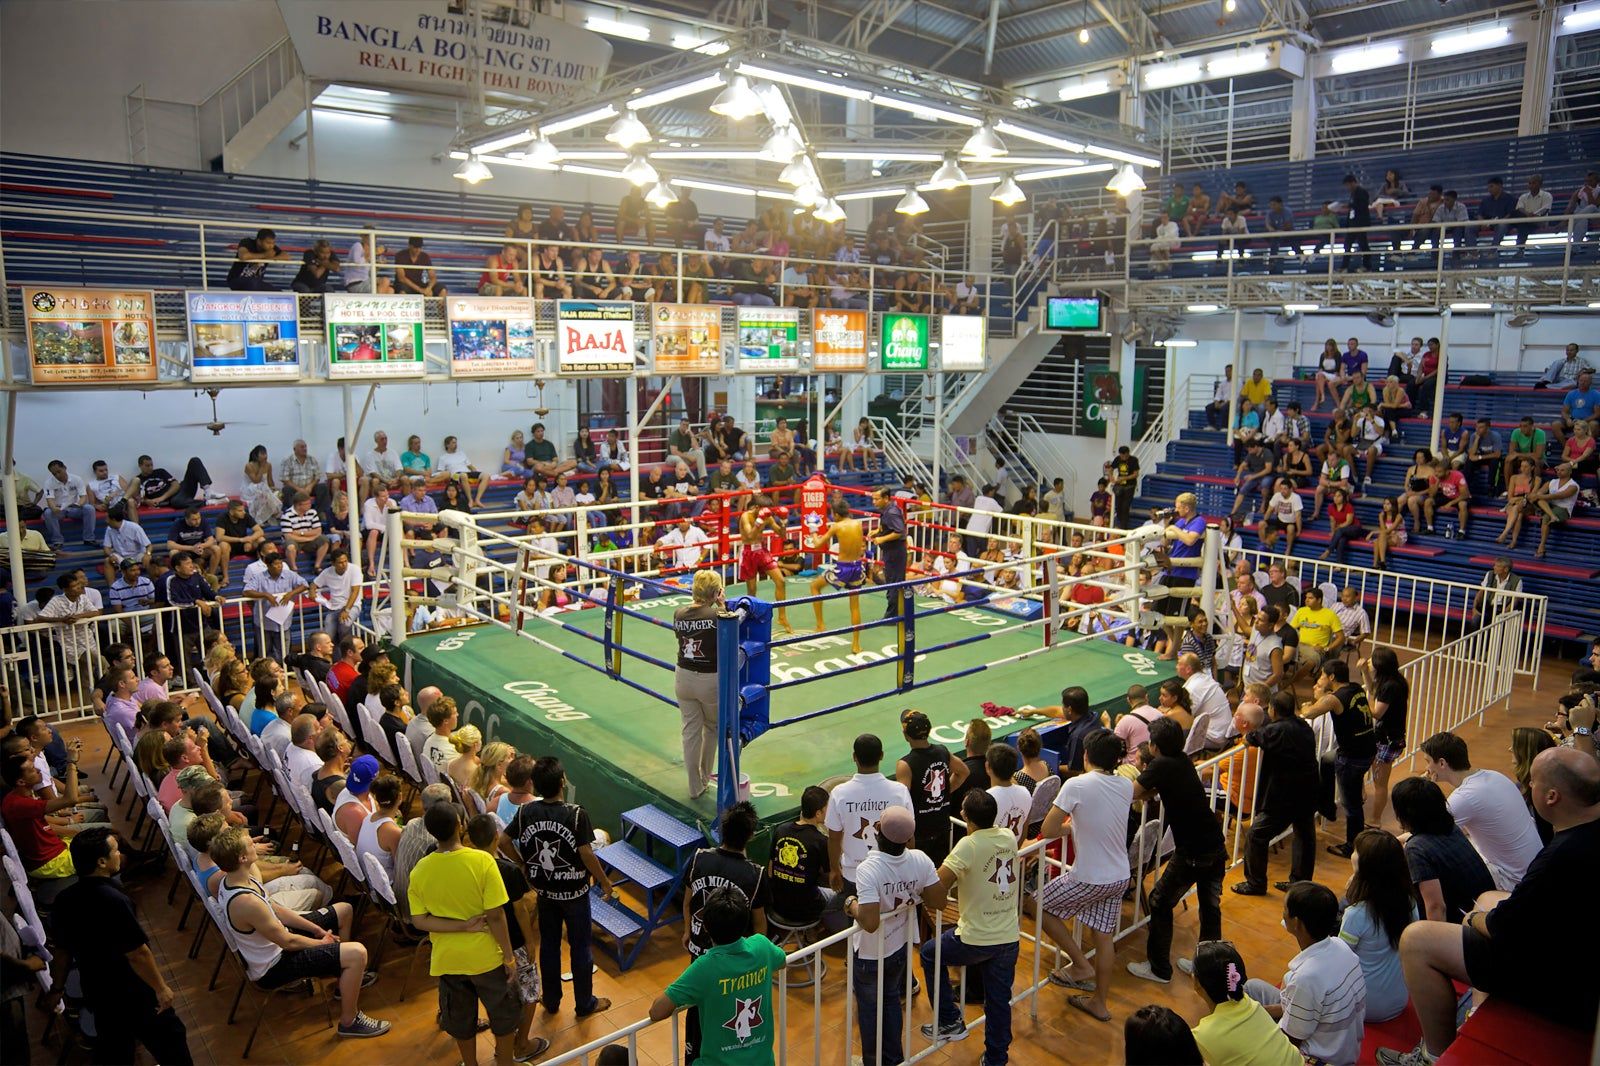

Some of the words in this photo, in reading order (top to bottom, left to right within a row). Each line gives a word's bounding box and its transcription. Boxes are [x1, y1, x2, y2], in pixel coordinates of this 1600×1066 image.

[418, 13, 551, 52] สนามวยบางลา
[317, 16, 424, 55] BANGLA
[529, 55, 600, 82] STADIUM
[359, 51, 412, 73] REAL
[483, 71, 521, 90] THAI
[57, 297, 112, 312] TIGER
[115, 298, 147, 312] INN
[191, 295, 241, 313] BANGKOK
[390, 301, 422, 310] CLUB
[566, 325, 628, 355] RAJA
[885, 342, 923, 361] Chang
[802, 491, 825, 502] TIGER
[503, 680, 593, 723] Chang
[845, 798, 891, 813] Trainer
[546, 884, 590, 900] THAILAND
[718, 963, 768, 996] Trainer
